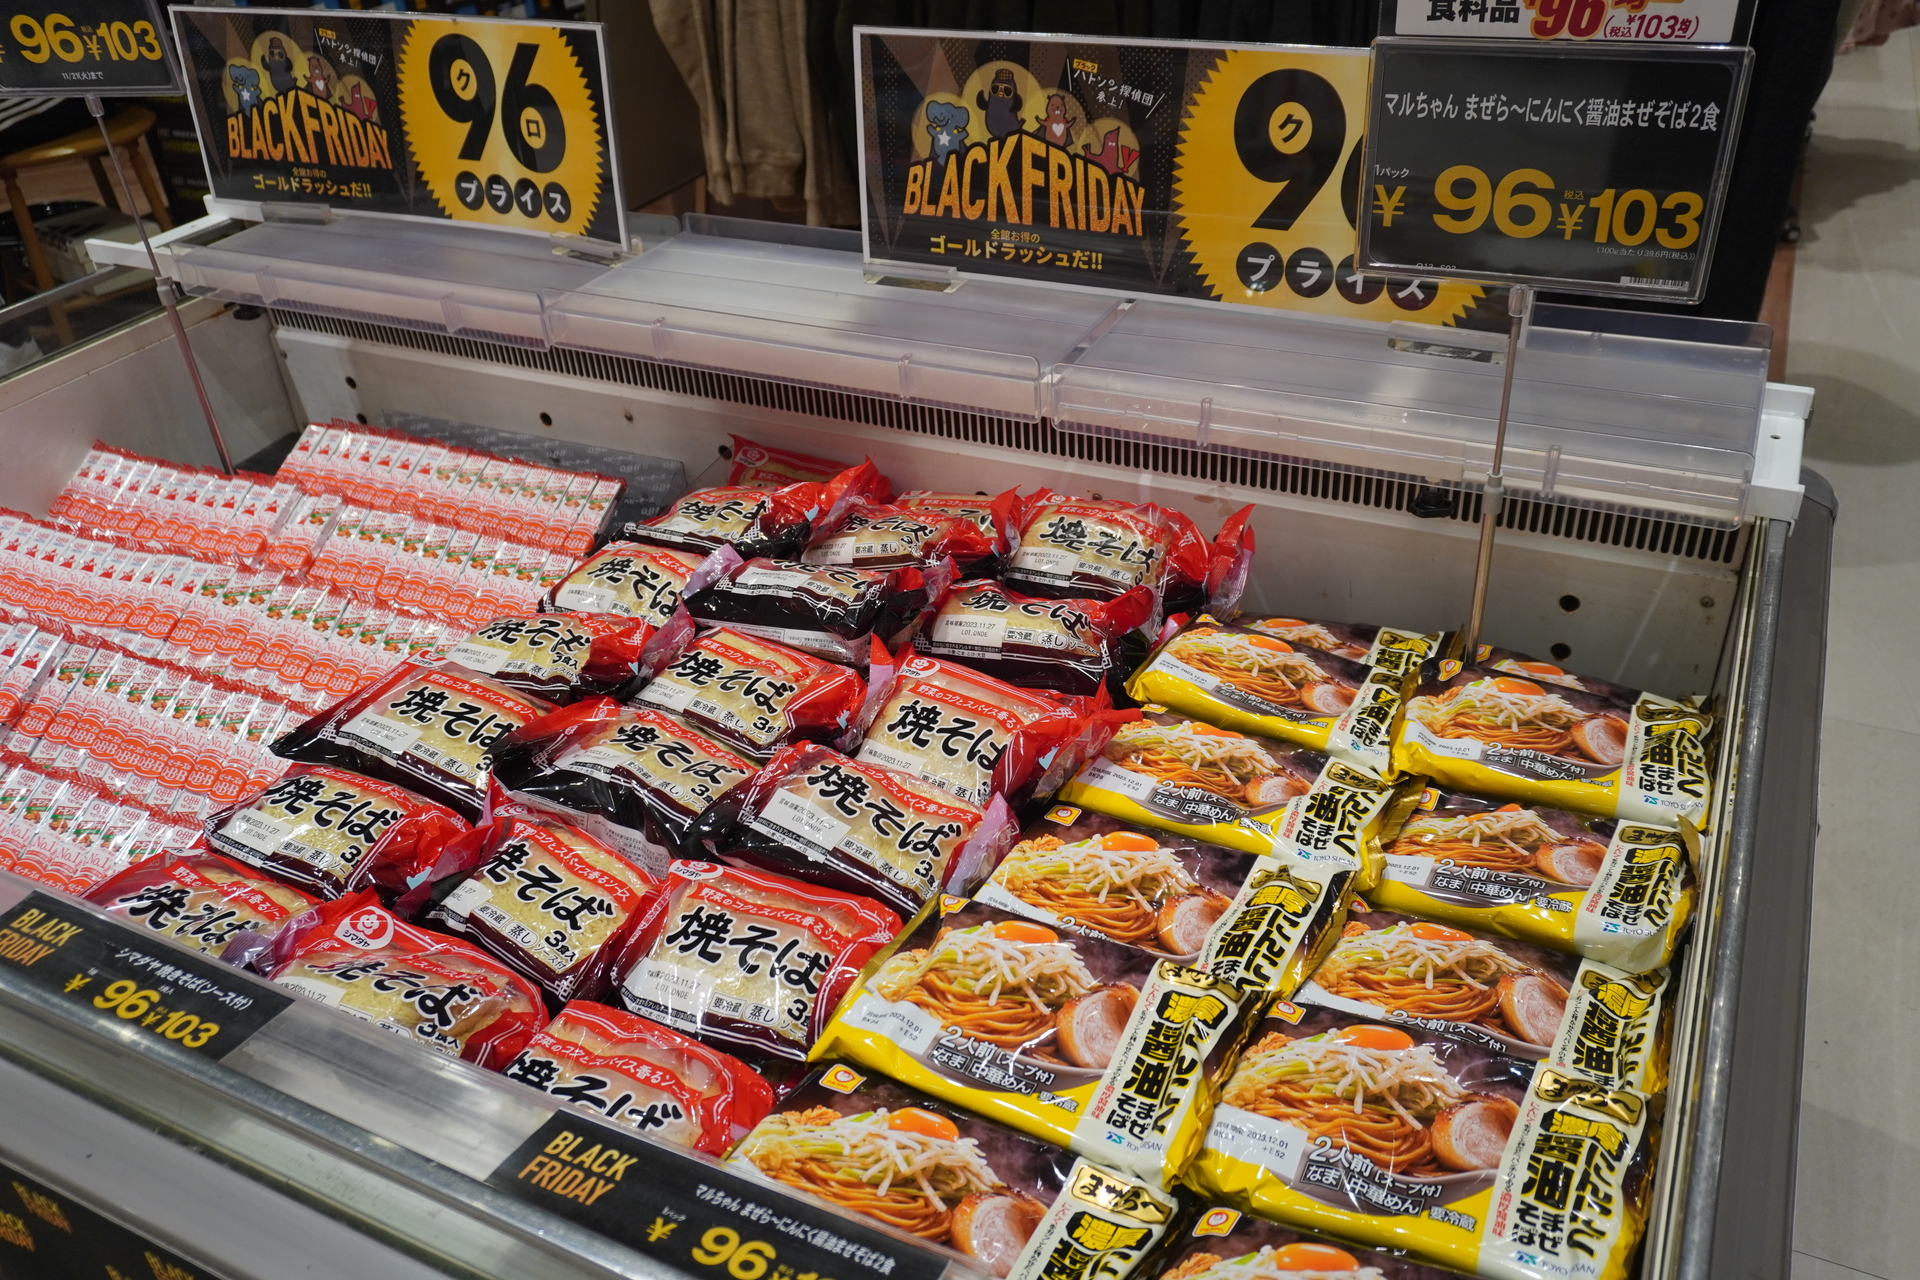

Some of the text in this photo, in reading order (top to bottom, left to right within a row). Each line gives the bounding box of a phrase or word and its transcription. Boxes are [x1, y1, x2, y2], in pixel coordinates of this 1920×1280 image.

[1427, 0, 1520, 24] 食料品
[10, 13, 85, 64] 96
[429, 33, 567, 174] 96
[1384, 92, 1459, 121] マルちゃん
[1234, 69, 1360, 232] 9
[1374, 163, 1410, 179] 1パック
[460, 179, 567, 216] プライス
[1432, 164, 1556, 239] 96
[1564, 190, 1585, 200] 税込
[990, 228, 1041, 244] 全館お得の
[930, 234, 1104, 270] ゴールドラッシュだ!!
[1109, 570, 1131, 582] 蒸し
[1006, 629, 1033, 642] 要冷蔵
[1041, 634, 1065, 646] 蒸し
[666, 651, 797, 715] 焼そば
[390, 685, 521, 751] 焼そば
[691, 699, 717, 715] 要冷蔵
[412, 743, 442, 760] 要冷蔵
[441, 757, 465, 774] 蒸し
[608, 724, 747, 786] 焼そば
[1487, 742, 1536, 760] 2人前
[1519, 759, 1574, 780] 中華めん
[658, 779, 680, 797] 蒸し
[1156, 779, 1203, 802] 2人前
[265, 774, 405, 845] 焼そば
[806, 764, 962, 858] 焼そば
[1153, 794, 1234, 822] なま 中華めん
[843, 840, 873, 860] 要冷蔵
[674, 866, 702, 878] シマダヤ
[878, 859, 905, 881] 蒸し
[1439, 858, 1547, 890] 2人前 [スープ付]
[485, 842, 616, 931] 焼そば
[1433, 874, 1530, 902] なま 中華めん
[1534, 895, 1573, 913] 要冷蔵
[10, 907, 84, 948] BLACK
[342, 929, 371, 949] シマダヤ
[507, 923, 534, 945] 蒸し
[533, 942, 568, 972] ソース付
[544, 930, 577, 963] 3食入
[665, 906, 836, 996] 焼そば
[114, 947, 254, 1011] シマダヤ焼きそば(ソース付)
[63, 973, 94, 993] ¥
[92, 979, 162, 1020] 96
[712, 997, 742, 1015] 要冷蔵
[748, 1004, 775, 1022] 蒸し
[1390, 1009, 1446, 1032] 2人前
[939, 1024, 998, 1060] 2人前
[931, 1046, 1033, 1095] なま 中華めん
[1246, 1130, 1289, 1149] 2023.12.01
[543, 1130, 640, 1182] BLACK
[1309, 1135, 1442, 1198] 2人前 [スープ付]
[517, 1154, 615, 1207] FRIDAY
[1304, 1164, 1421, 1216] なま 中華めん
[694, 1183, 744, 1213] マルちゃん
[1429, 1206, 1477, 1233] 要冷蔵
[645, 1216, 679, 1244] ¥
[691, 1225, 778, 1280] 96
